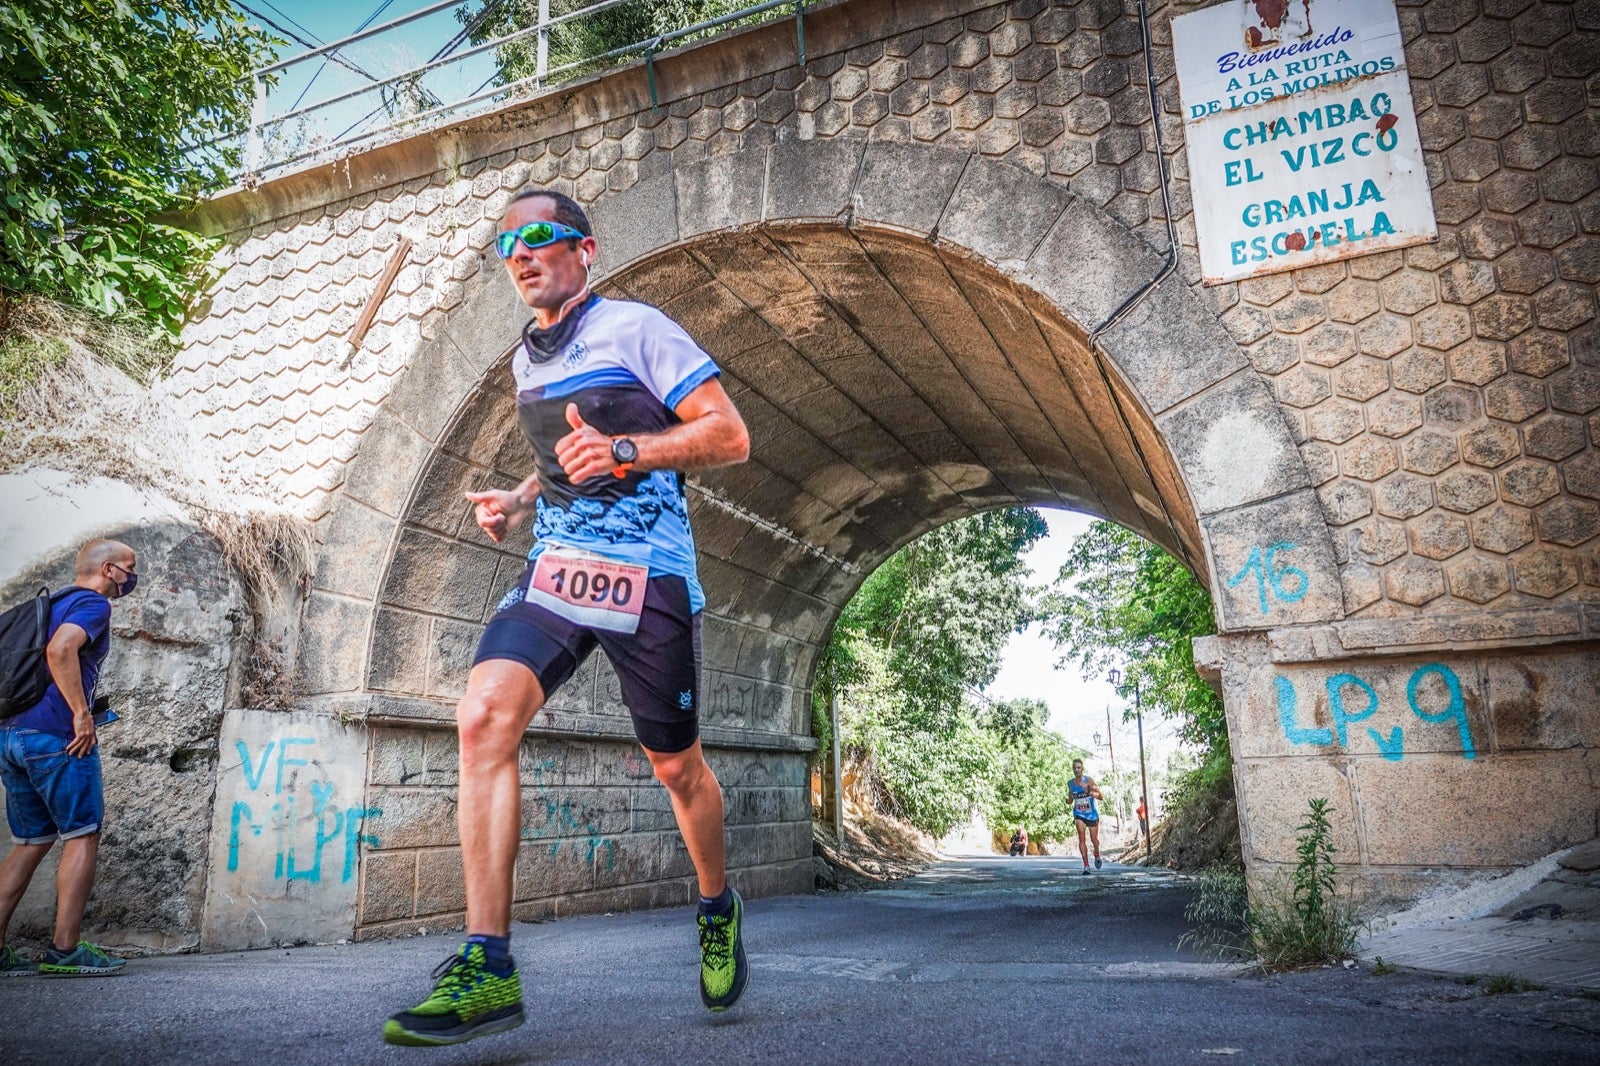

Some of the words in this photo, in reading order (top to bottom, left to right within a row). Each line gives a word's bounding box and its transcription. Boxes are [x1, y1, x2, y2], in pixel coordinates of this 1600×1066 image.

[1216, 26, 1355, 74] Bienvenido
[1226, 77, 1242, 92] A
[1249, 68, 1281, 87] LA
[1285, 49, 1353, 77] RUTA
[1190, 99, 1222, 119] DE
[1229, 87, 1275, 110] LOS
[1282, 55, 1396, 97] MOLINOS
[1224, 158, 1264, 187] EL
[1280, 126, 1399, 173] VIZCO
[1242, 178, 1386, 228] GRANJA
[1230, 211, 1397, 265] ESCUELA
[551, 567, 633, 607] 1090
[1227, 541, 1309, 615] 16
[235, 737, 316, 794] VF
